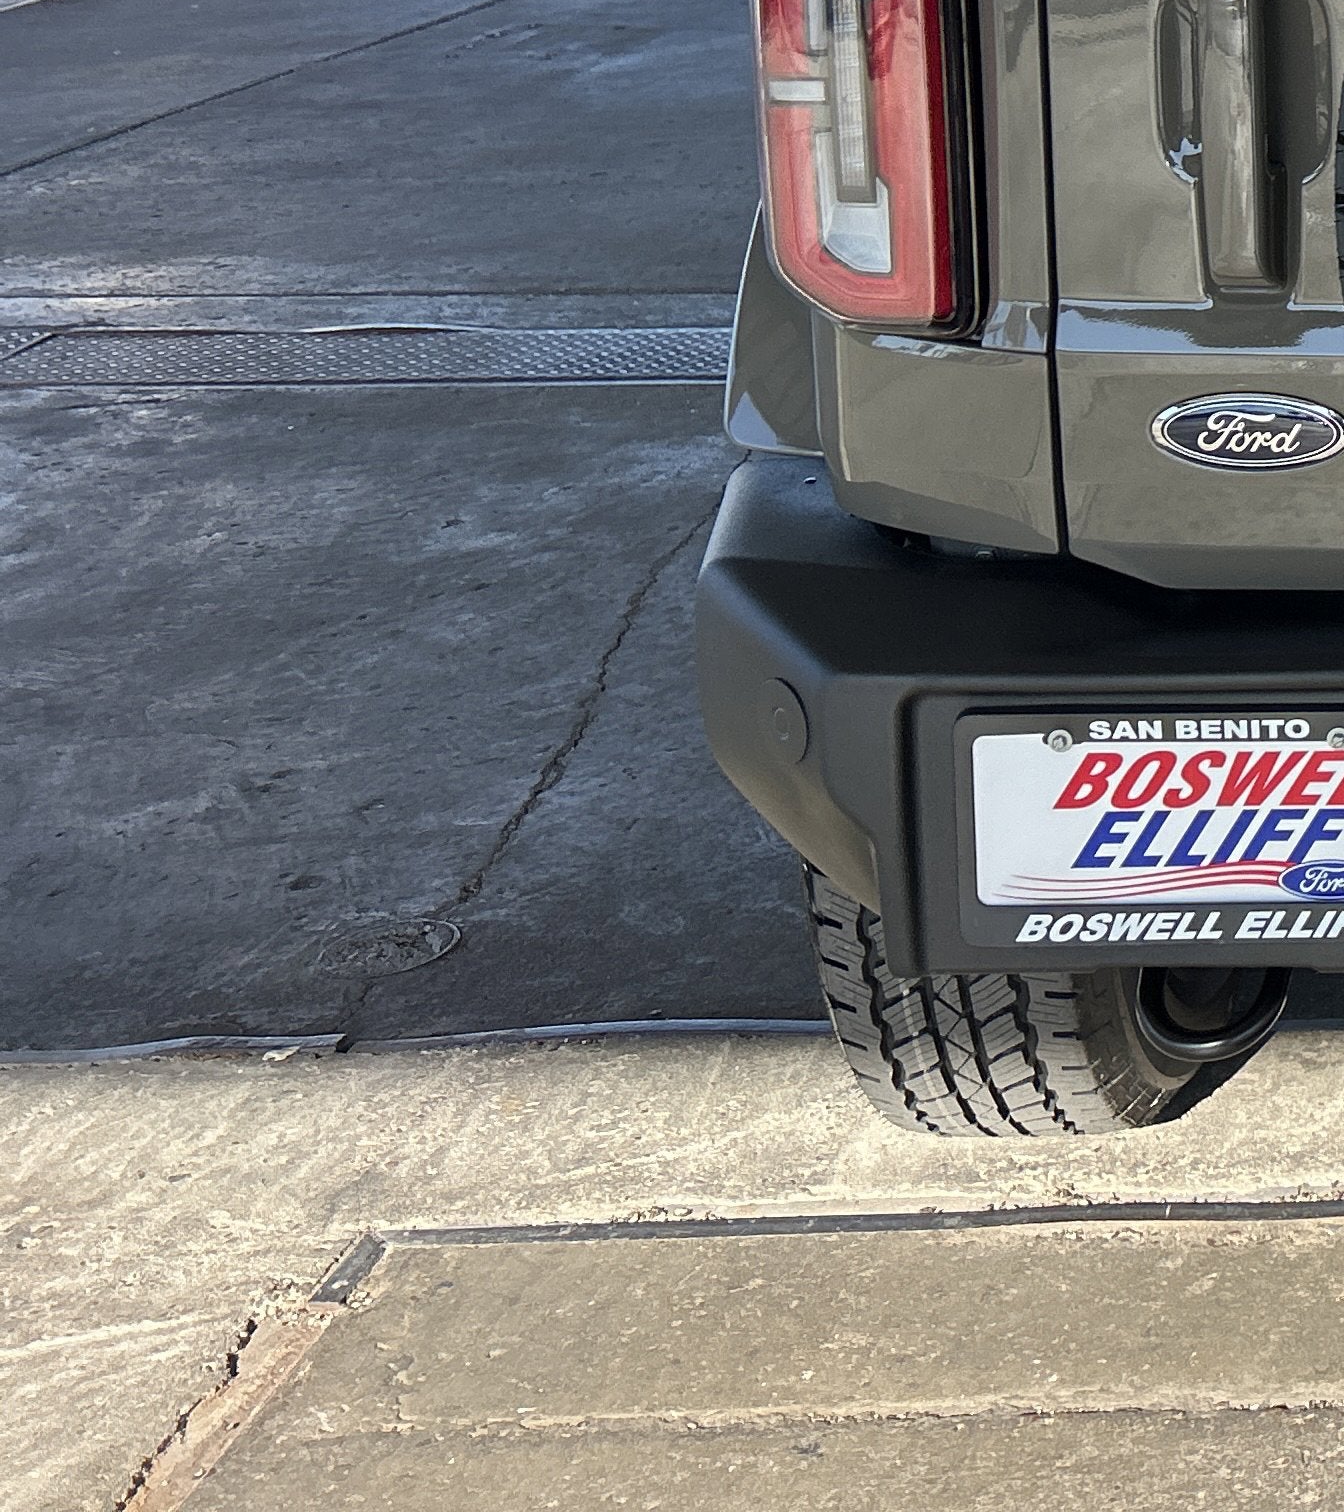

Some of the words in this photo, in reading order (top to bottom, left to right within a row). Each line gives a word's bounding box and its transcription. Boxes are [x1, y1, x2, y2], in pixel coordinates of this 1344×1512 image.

[1196, 410, 1303, 453] Ford
[1088, 720, 1167, 741] SAN
[1175, 719, 1311, 740] BENITO
[1015, 911, 1224, 944] BOSWELL
